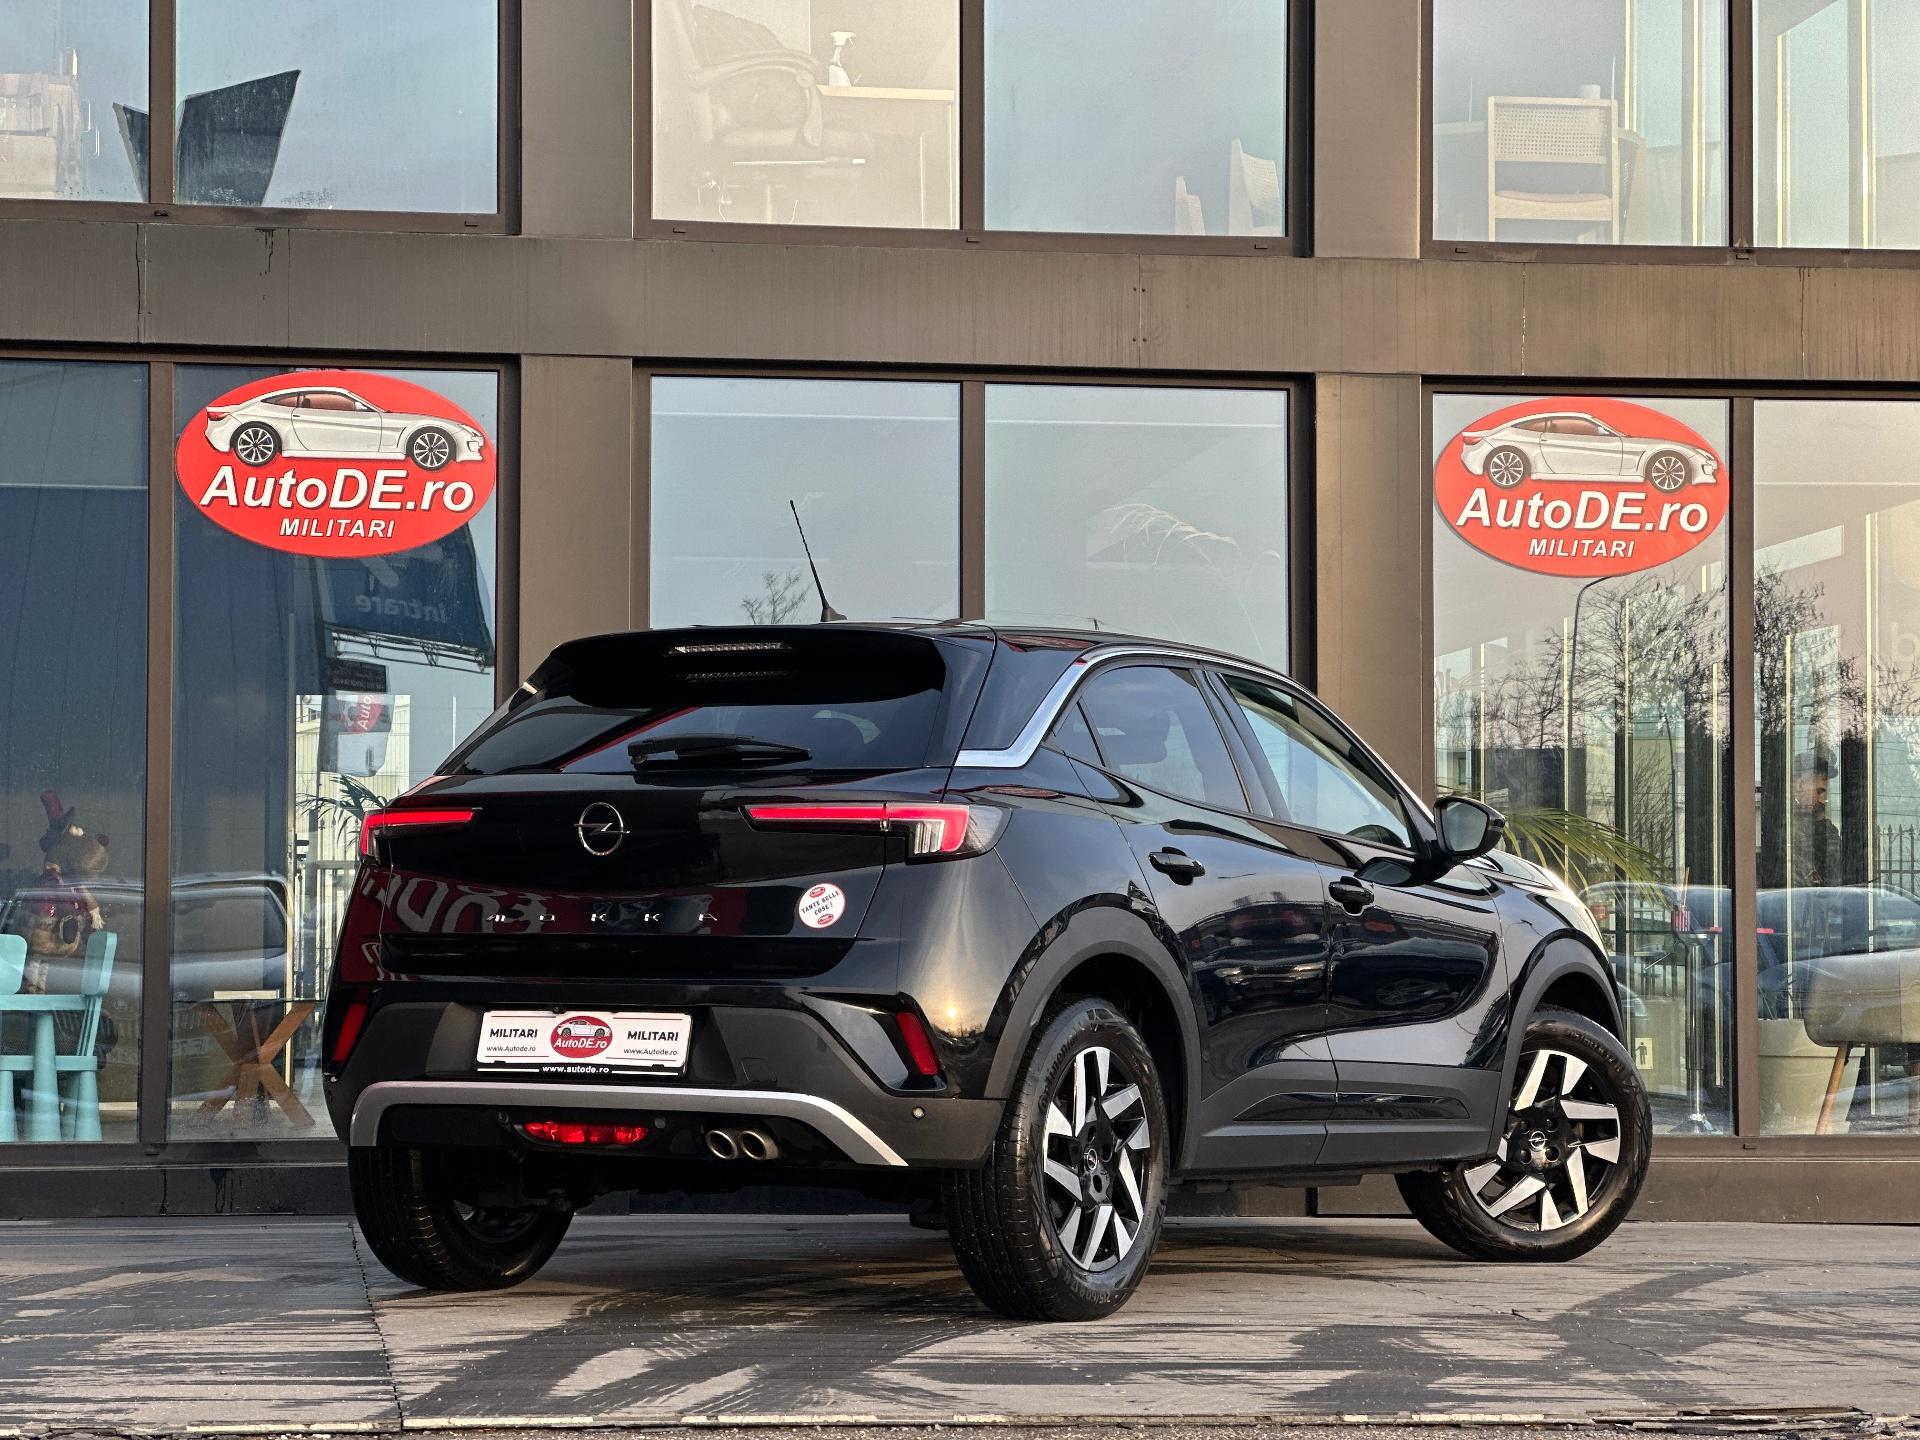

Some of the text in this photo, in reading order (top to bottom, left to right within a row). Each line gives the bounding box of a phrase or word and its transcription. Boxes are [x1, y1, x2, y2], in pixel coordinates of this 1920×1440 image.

[200, 465, 475, 513] AutoDE.ro
[1456, 487, 1709, 534] AutoDE.ro
[279, 518, 396, 538] MILITARI
[1528, 538, 1636, 558] MILITARI
[358, 694, 376, 730] Auto
[801, 900, 820, 914] TANTE
[821, 890, 840, 903] BELLE
[486, 913, 718, 922] MOKKA
[489, 1028, 538, 1038] MILITARI
[627, 1030, 679, 1042] MILITARI
[486, 1044, 537, 1053] www.Autode.ro
[553, 1038, 607, 1050] AutoDE.ro
[623, 1047, 678, 1056] www.Autode.ro
[542, 1065, 610, 1074] www.autode.ro
